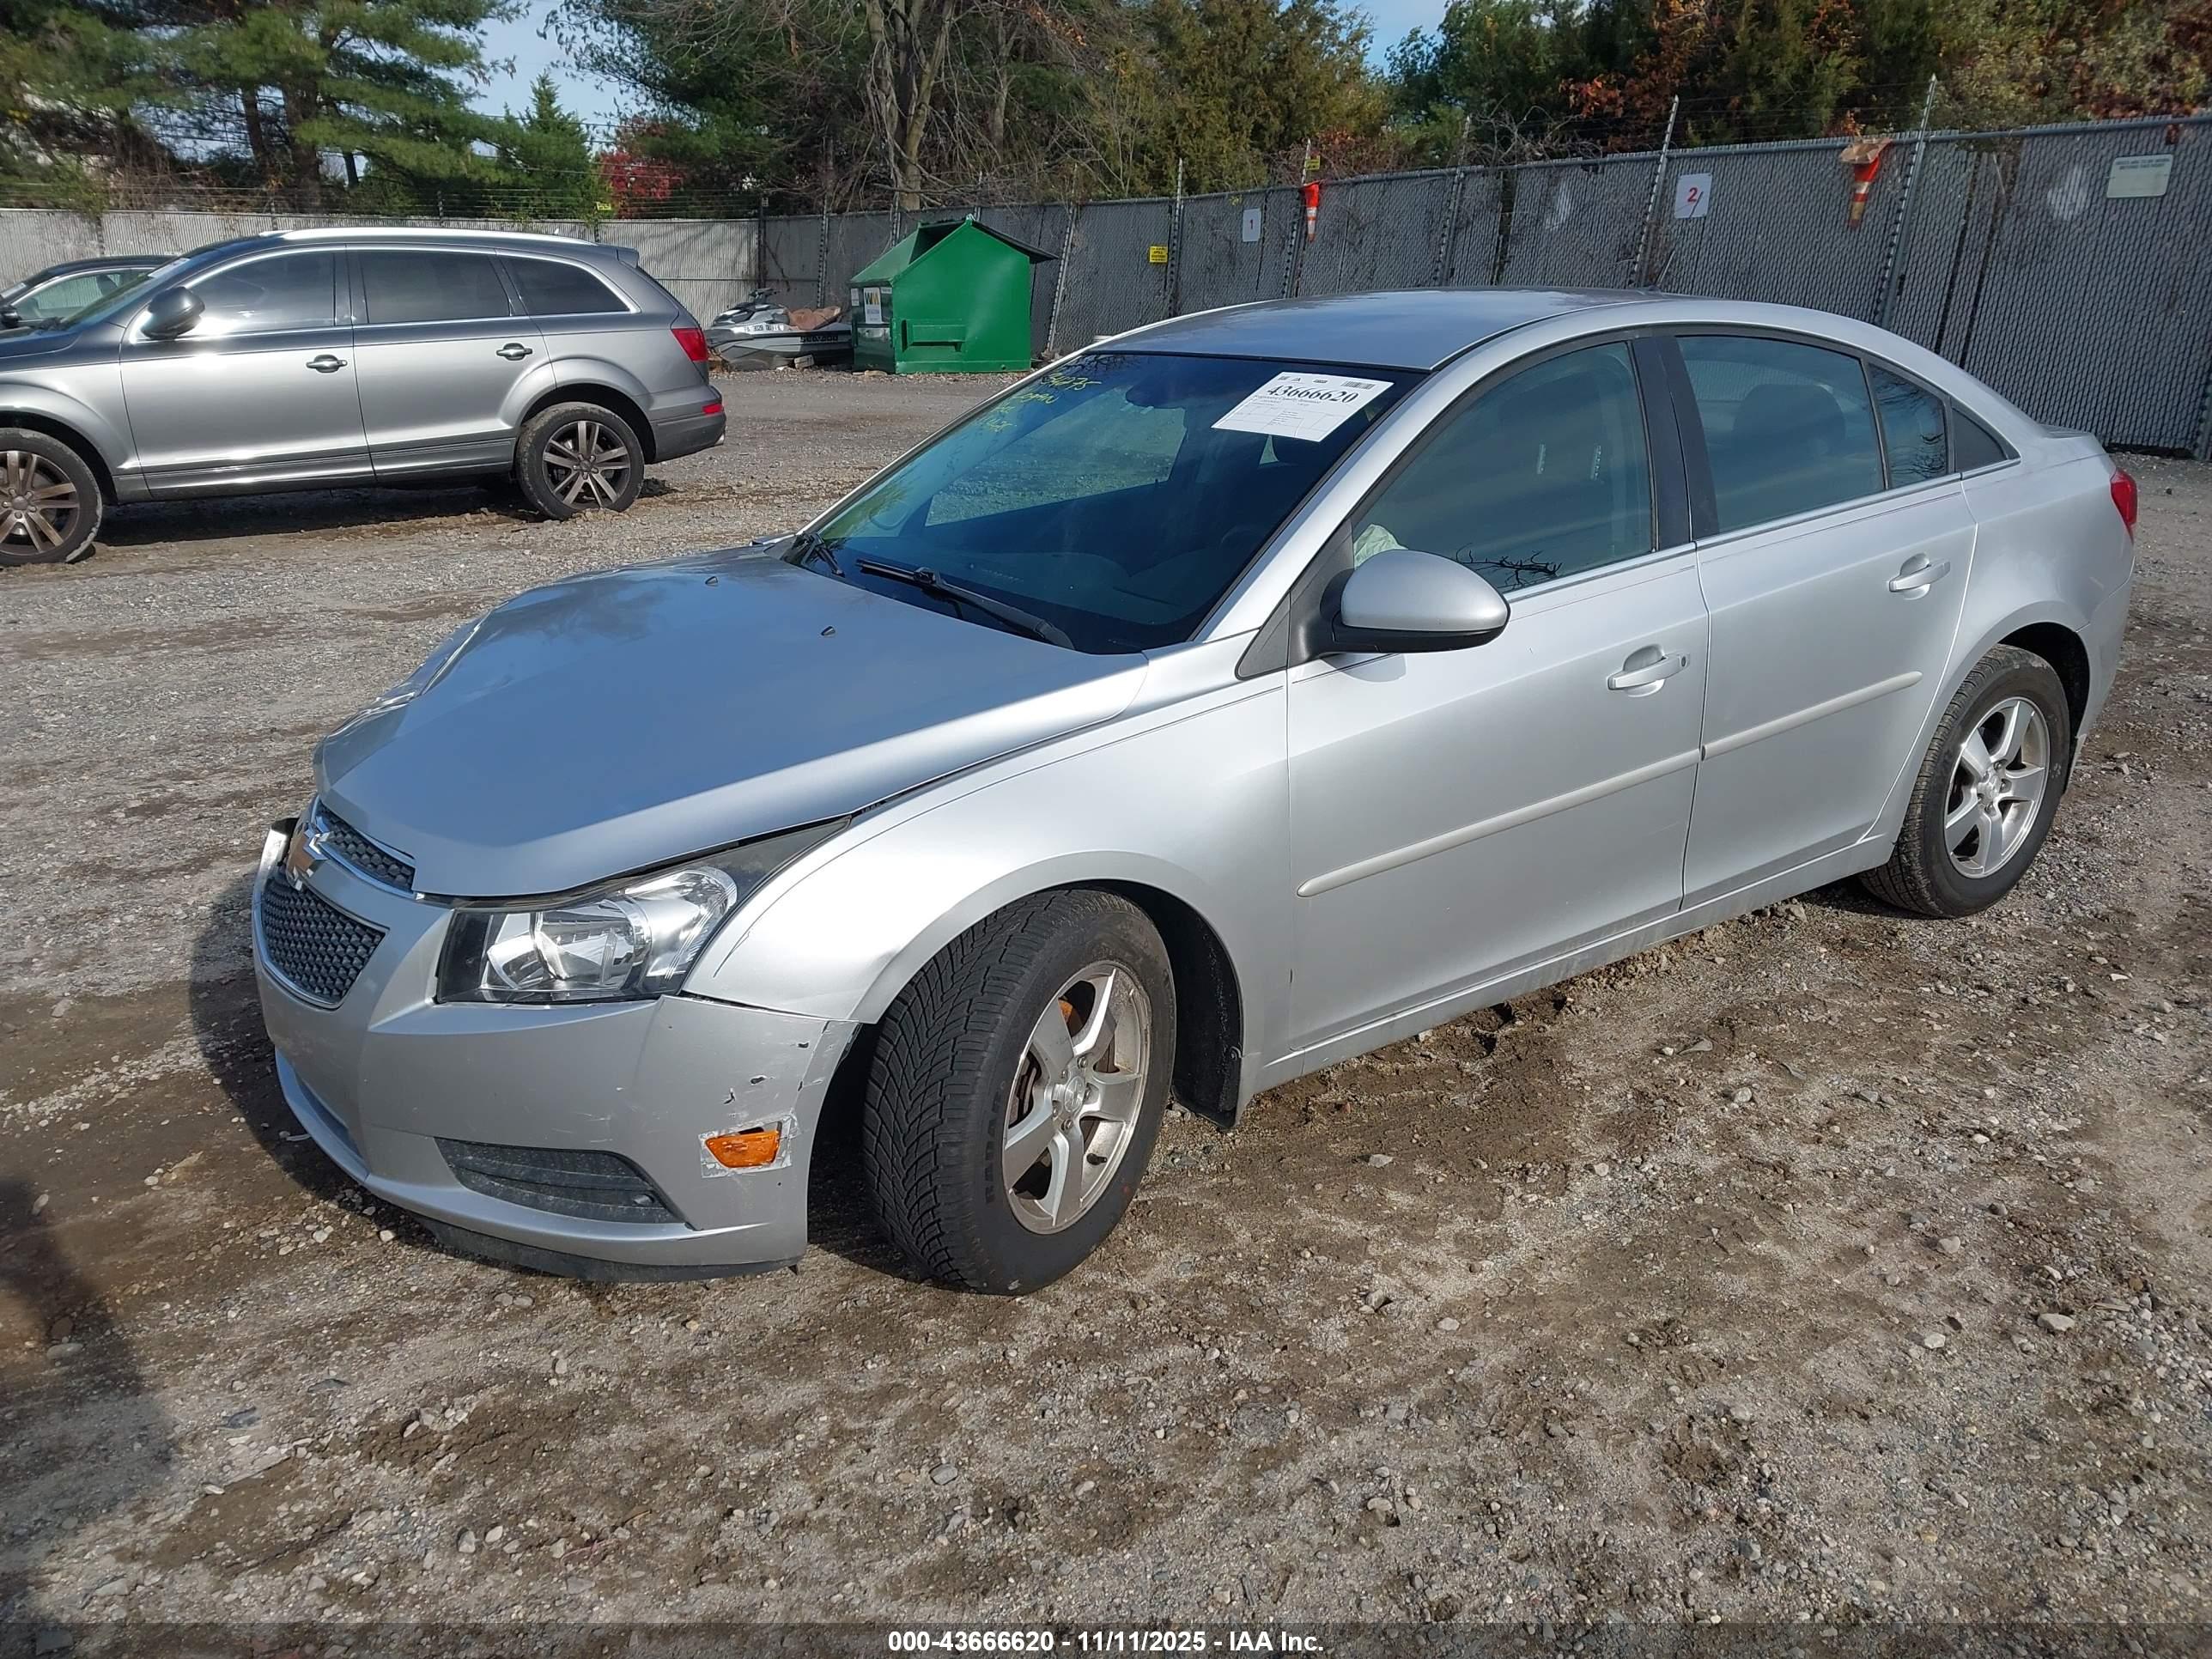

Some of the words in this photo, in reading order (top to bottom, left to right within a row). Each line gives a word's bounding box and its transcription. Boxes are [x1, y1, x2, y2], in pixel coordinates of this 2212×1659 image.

[1687, 187, 1698, 203] 2
[1249, 219, 1254, 230] 1
[1267, 385, 1359, 404] 43666620
